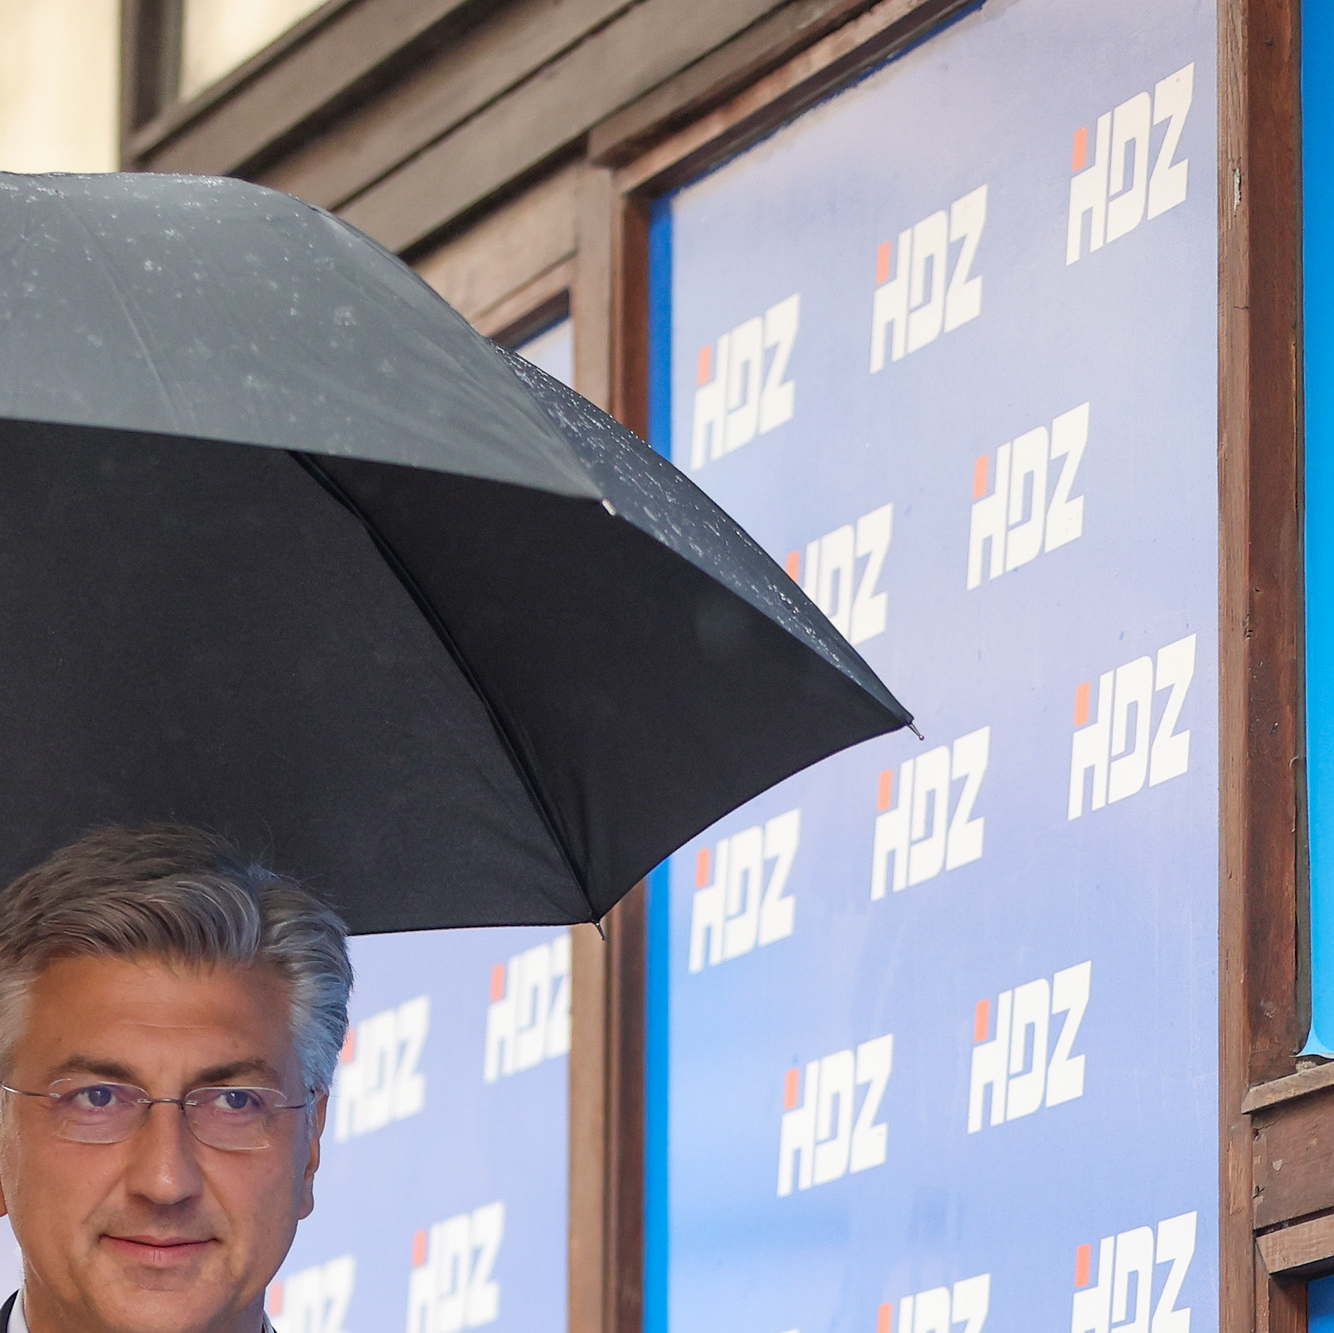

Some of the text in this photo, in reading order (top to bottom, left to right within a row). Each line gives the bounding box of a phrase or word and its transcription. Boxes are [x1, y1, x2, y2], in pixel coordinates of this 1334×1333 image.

[1066, 63, 1194, 265] HDZ
[870, 185, 987, 372] HDZ
[691, 294, 799, 470] HDZ
[967, 402, 1089, 589] HDZ
[871, 726, 989, 901] HDZ
[1068, 633, 1196, 820] HDZ
[689, 809, 800, 973] HDZ
[334, 994, 430, 1143] HDZ
[778, 1034, 893, 1196] HDZ
[968, 961, 1091, 1133] HDZ
